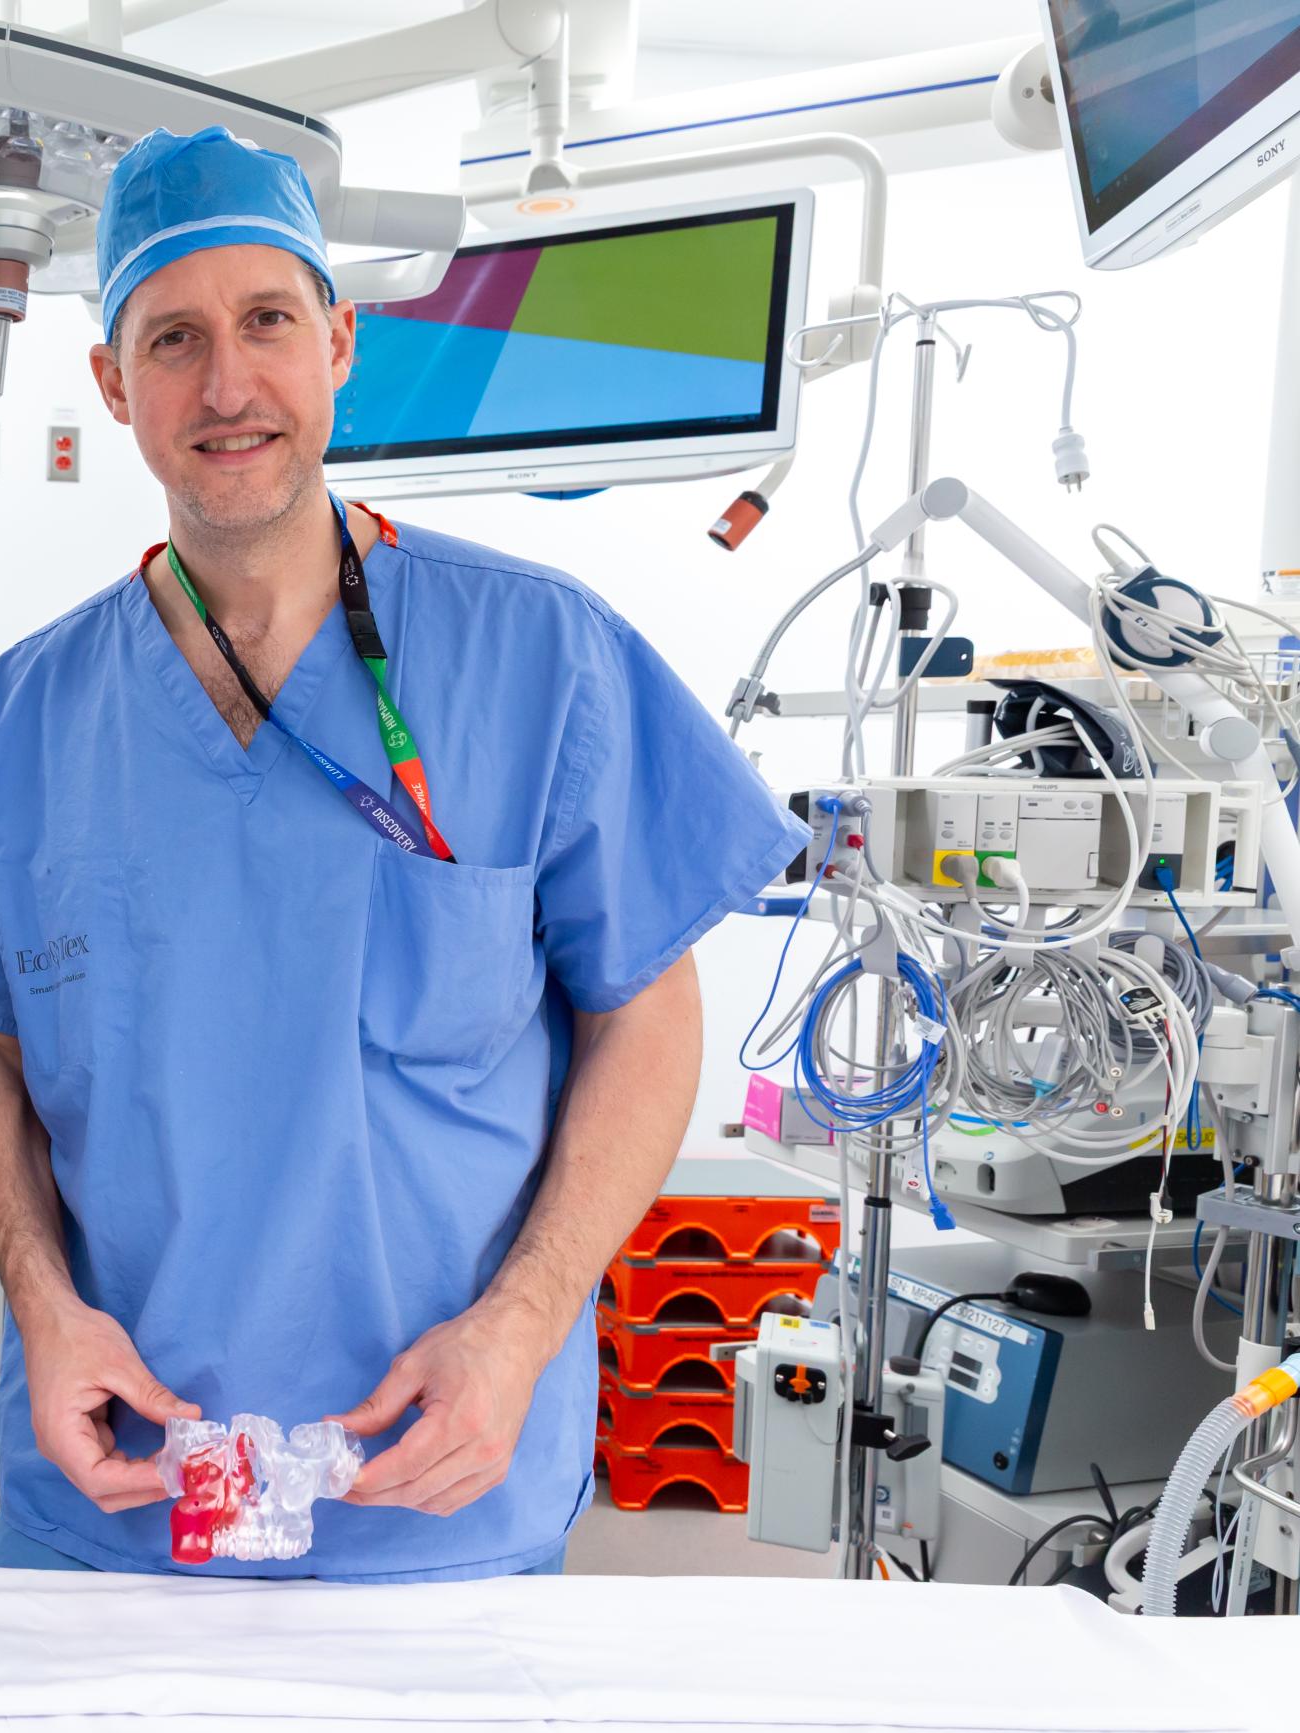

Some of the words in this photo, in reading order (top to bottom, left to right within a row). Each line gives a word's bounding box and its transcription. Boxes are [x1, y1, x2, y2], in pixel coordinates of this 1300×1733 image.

[1256, 139, 1287, 167] SONY
[507, 472, 538, 480] SONY
[371, 807, 418, 852] DISCOVERY
